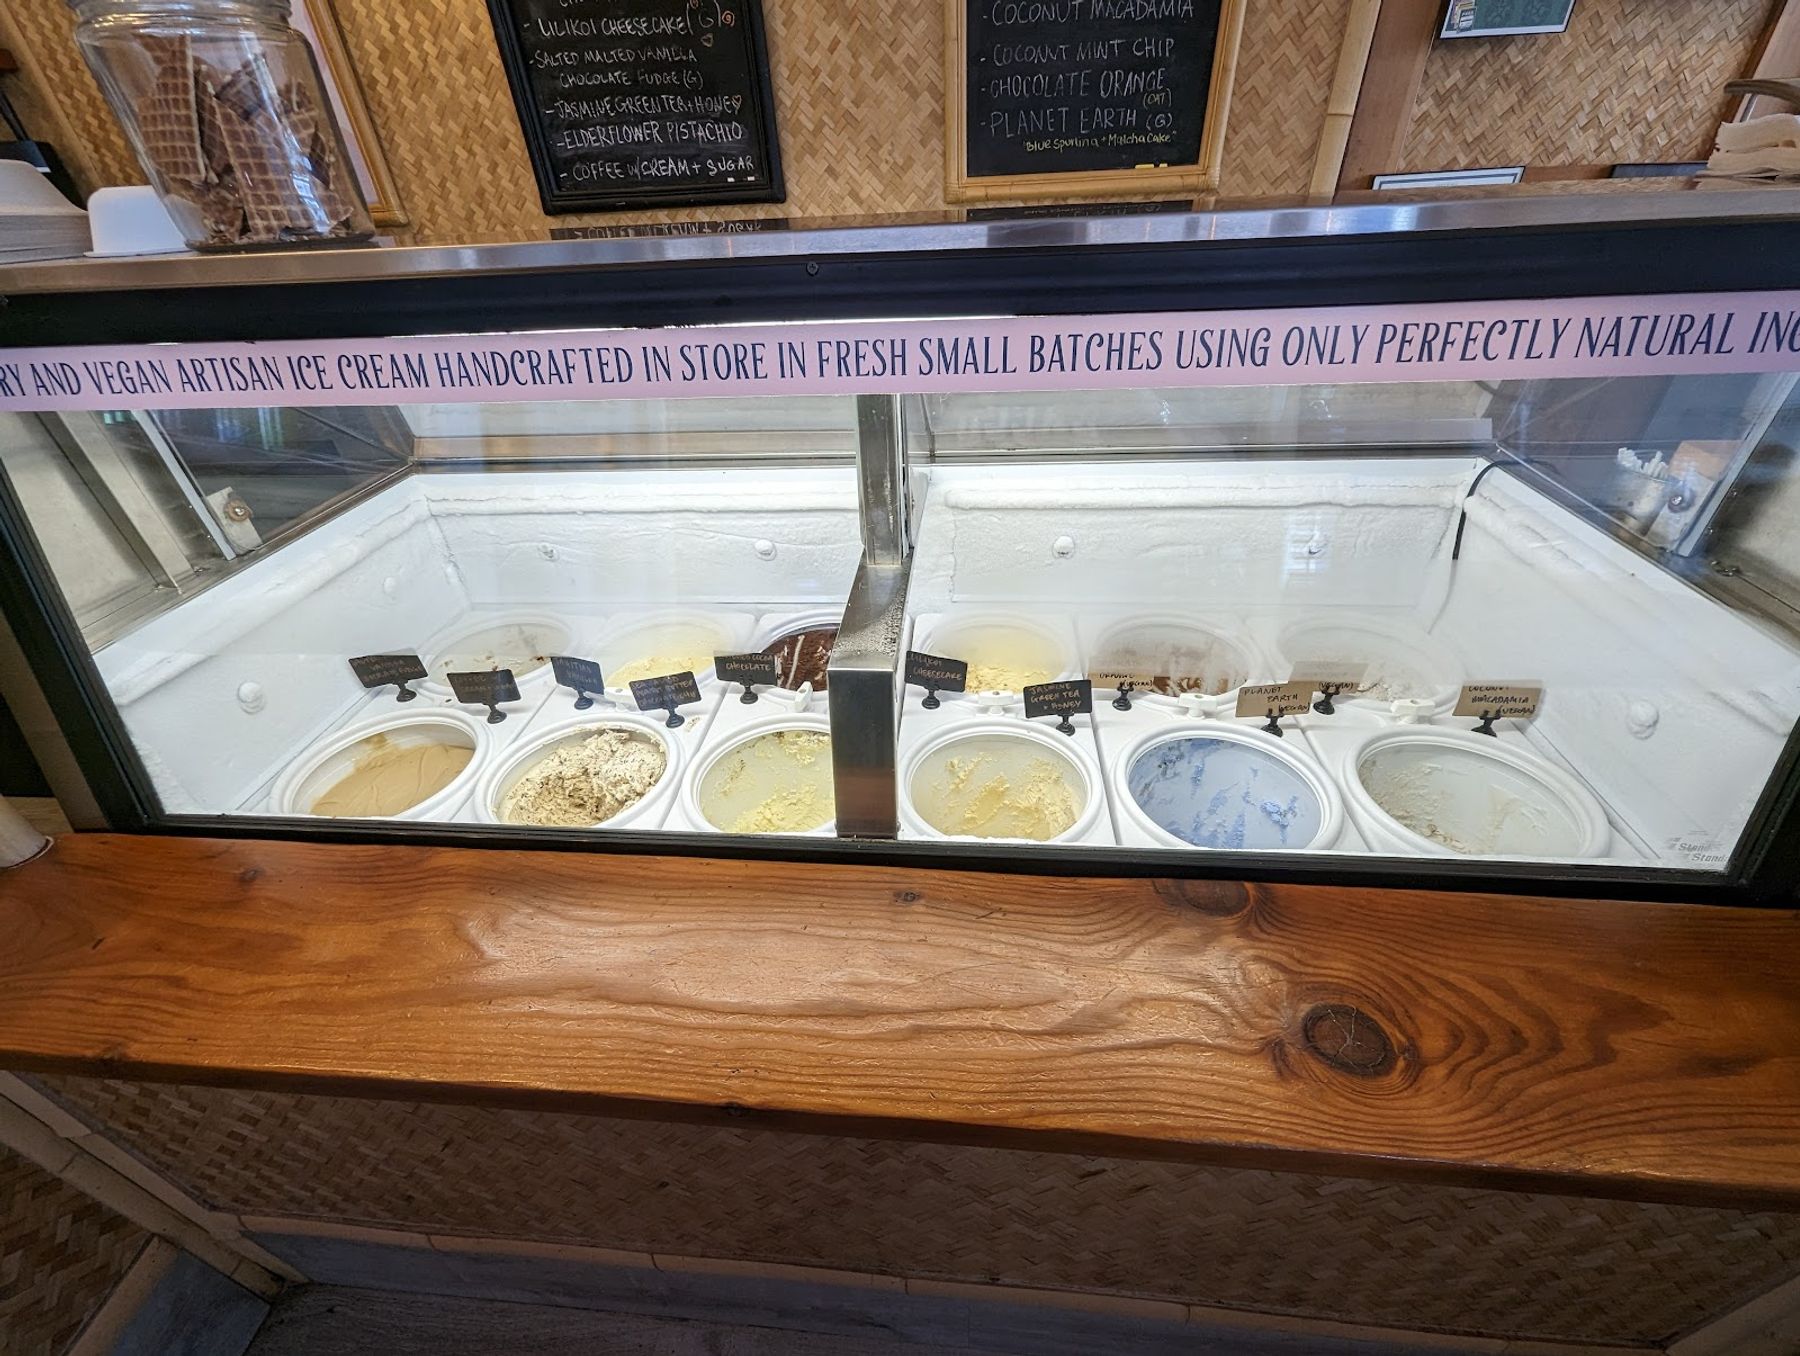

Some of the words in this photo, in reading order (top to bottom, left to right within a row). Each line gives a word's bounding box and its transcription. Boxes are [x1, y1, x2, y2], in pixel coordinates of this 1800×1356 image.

[992, 0, 1083, 25] COCONUT
[1090, 0, 1194, 20] MACADAMIA
[538, 17, 597, 37] LILIKOI
[584, 48, 636, 64] MALTED
[638, 46, 697, 62] VANILLA
[993, 43, 1069, 66] COCONUT
[1077, 39, 1126, 61] MINT
[1133, 37, 1174, 58] CHIP
[559, 71, 631, 88] CHOCOLATE
[637, 69, 680, 85] FUDGE
[990, 69, 1092, 98] CHOCOLATE
[1100, 67, 1166, 99] ORANGE
[615, 95, 661, 114] GREEN
[666, 121, 743, 142] PISTACHIO
[990, 107, 1070, 138] PLANET
[1080, 107, 1137, 134] EARTH
[1145, 112, 1173, 131] (G)
[572, 162, 625, 181] COFFEE
[706, 155, 755, 177] SUGAR
[30, 362, 81, 396] AND
[83, 360, 173, 394] VEGAN
[176, 355, 285, 392] ARTISAN
[286, 354, 333, 390] ICE
[337, 352, 430, 388] CREAM
[434, 347, 634, 388] HANDCRAFTED
[642, 345, 671, 382] IN
[680, 342, 768, 381] STORE
[778, 341, 807, 379] IN
[817, 338, 908, 378] FRESH
[918, 336, 1017, 375] SMALL
[1028, 330, 1163, 372] BATCHES
[1175, 327, 1271, 369] USING
[1281, 324, 1371, 366] ONLY
[1374, 318, 1572, 363] PERFECTLY
[1573, 312, 1736, 358] NATURAL
[725, 661, 772, 672] CHOCOLATE
[1243, 686, 1282, 696] PLANET
[1266, 693, 1299, 703] EARTH
